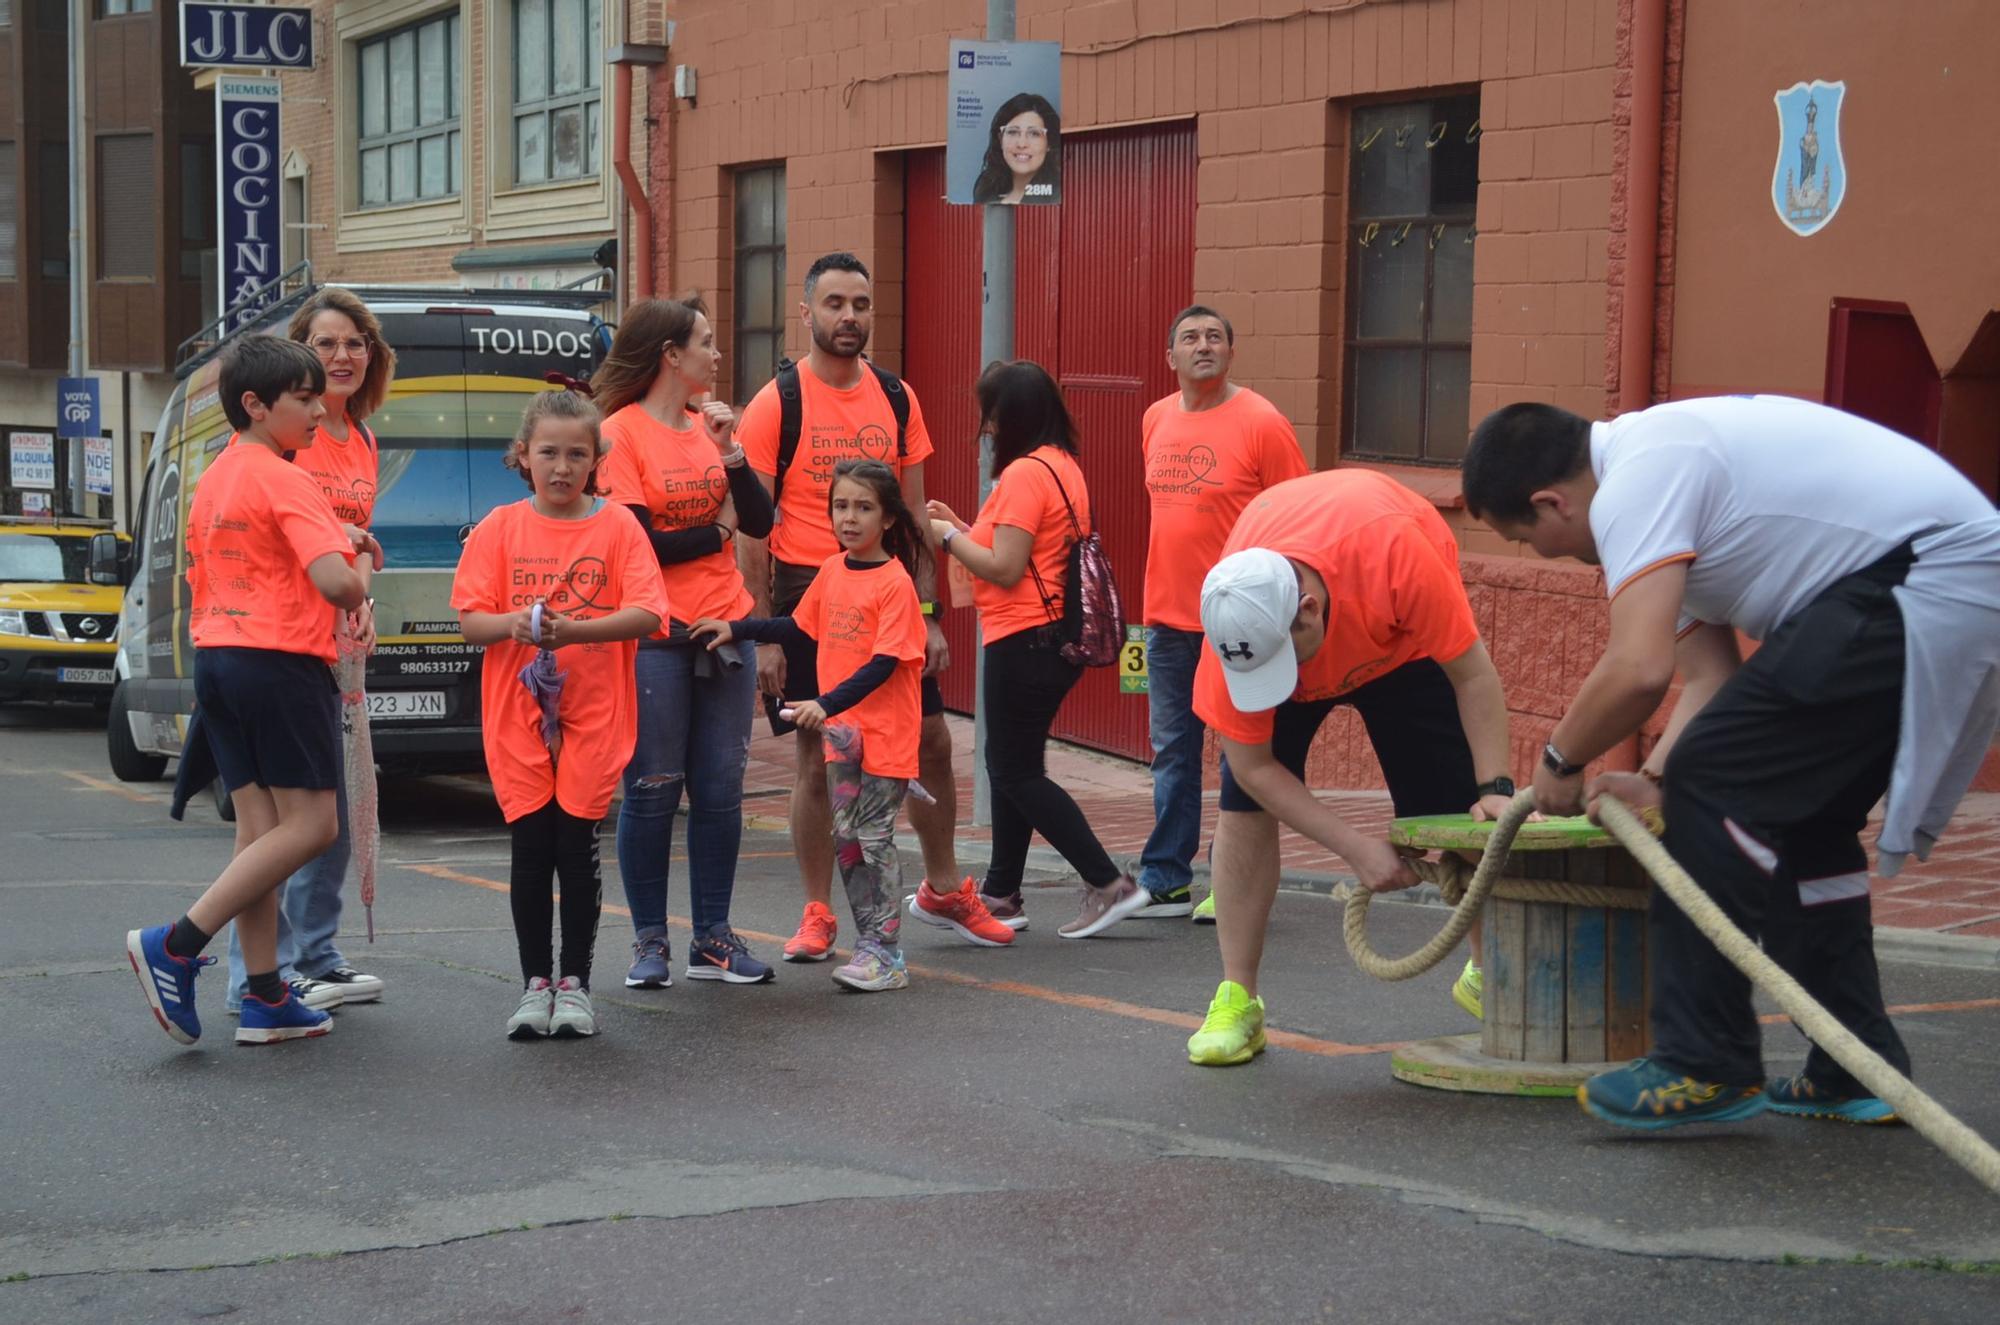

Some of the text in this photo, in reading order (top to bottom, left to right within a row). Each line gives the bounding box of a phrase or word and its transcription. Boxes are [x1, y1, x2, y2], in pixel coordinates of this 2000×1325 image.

[191, 10, 308, 63] JLC
[224, 83, 279, 95] SIEMENS
[1025, 184, 1053, 196] 28M
[470, 328, 591, 358] TOLDOS
[64, 392, 92, 402] VOTA
[812, 433, 893, 448] En marcha
[87, 454, 111, 470] NDE
[1170, 453, 1217, 468] marcha
[1151, 467, 1189, 479] contra
[665, 479, 682, 493] En
[333, 504, 358, 519] ntra
[512, 568, 608, 587] En marcha
[415, 623, 461, 632] MAMPAR
[372, 646, 417, 655] ERRAZAS
[425, 644, 464, 655] TECHOS
[1128, 646, 1143, 672] 3
[400, 661, 470, 674] 980633127
[65, 670, 112, 681] 0057 GN
[406, 695, 441, 712] JXN
